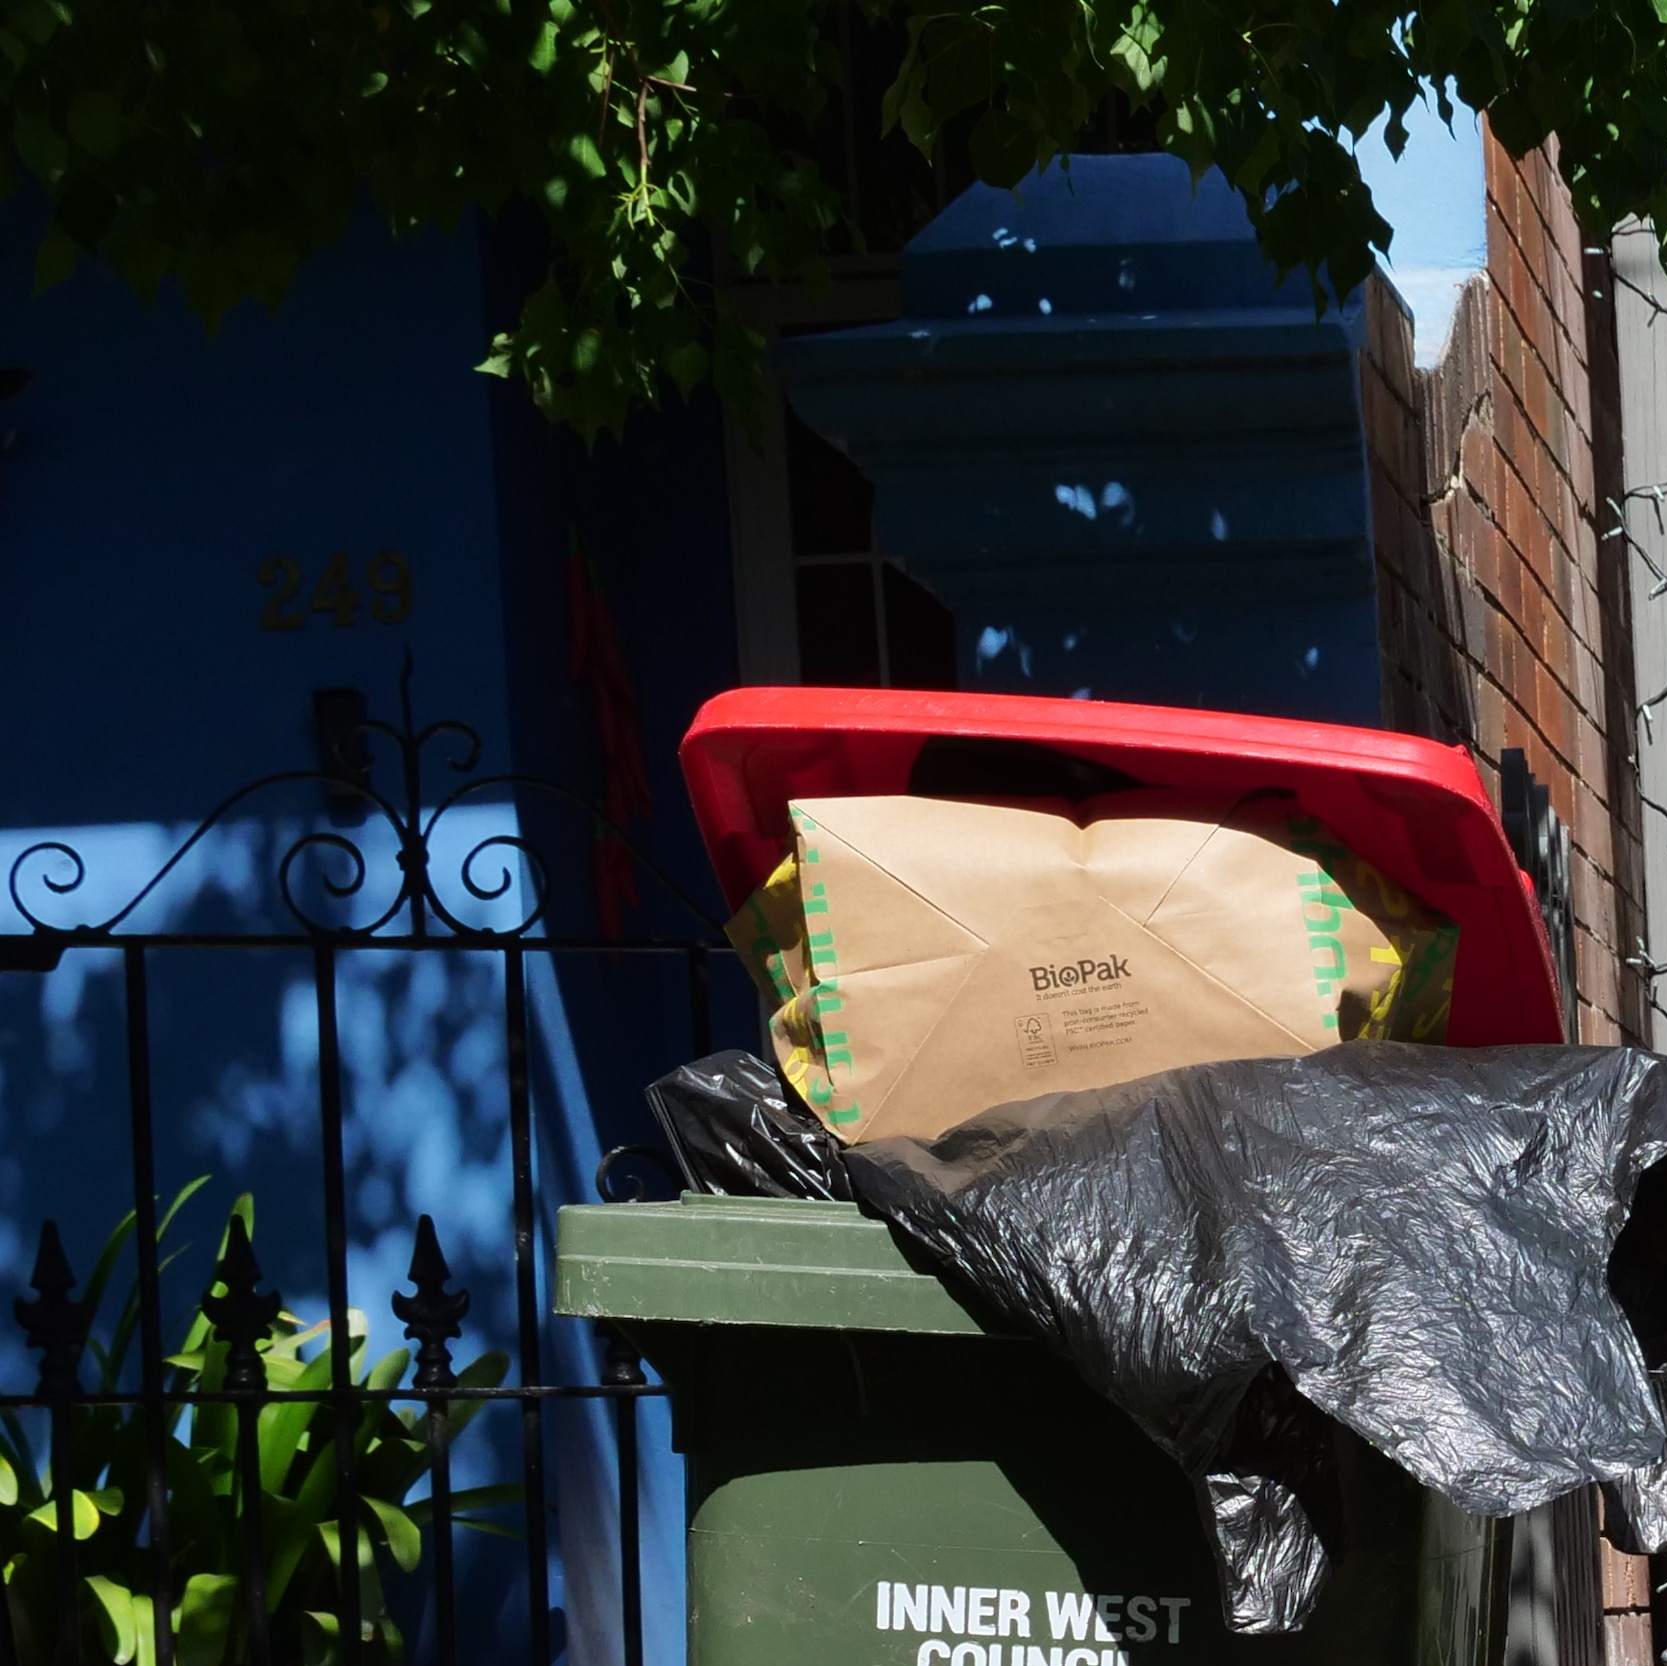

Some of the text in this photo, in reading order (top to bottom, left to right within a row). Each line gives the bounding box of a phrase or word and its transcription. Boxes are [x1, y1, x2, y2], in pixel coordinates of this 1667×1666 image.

[257, 551, 413, 630] 249
[1030, 954, 1131, 991] BioPak
[1071, 987, 1087, 996] cost
[1088, 985, 1101, 994] the
[1102, 982, 1122, 991] earth
[876, 1581, 1191, 1644] INNER WEST
